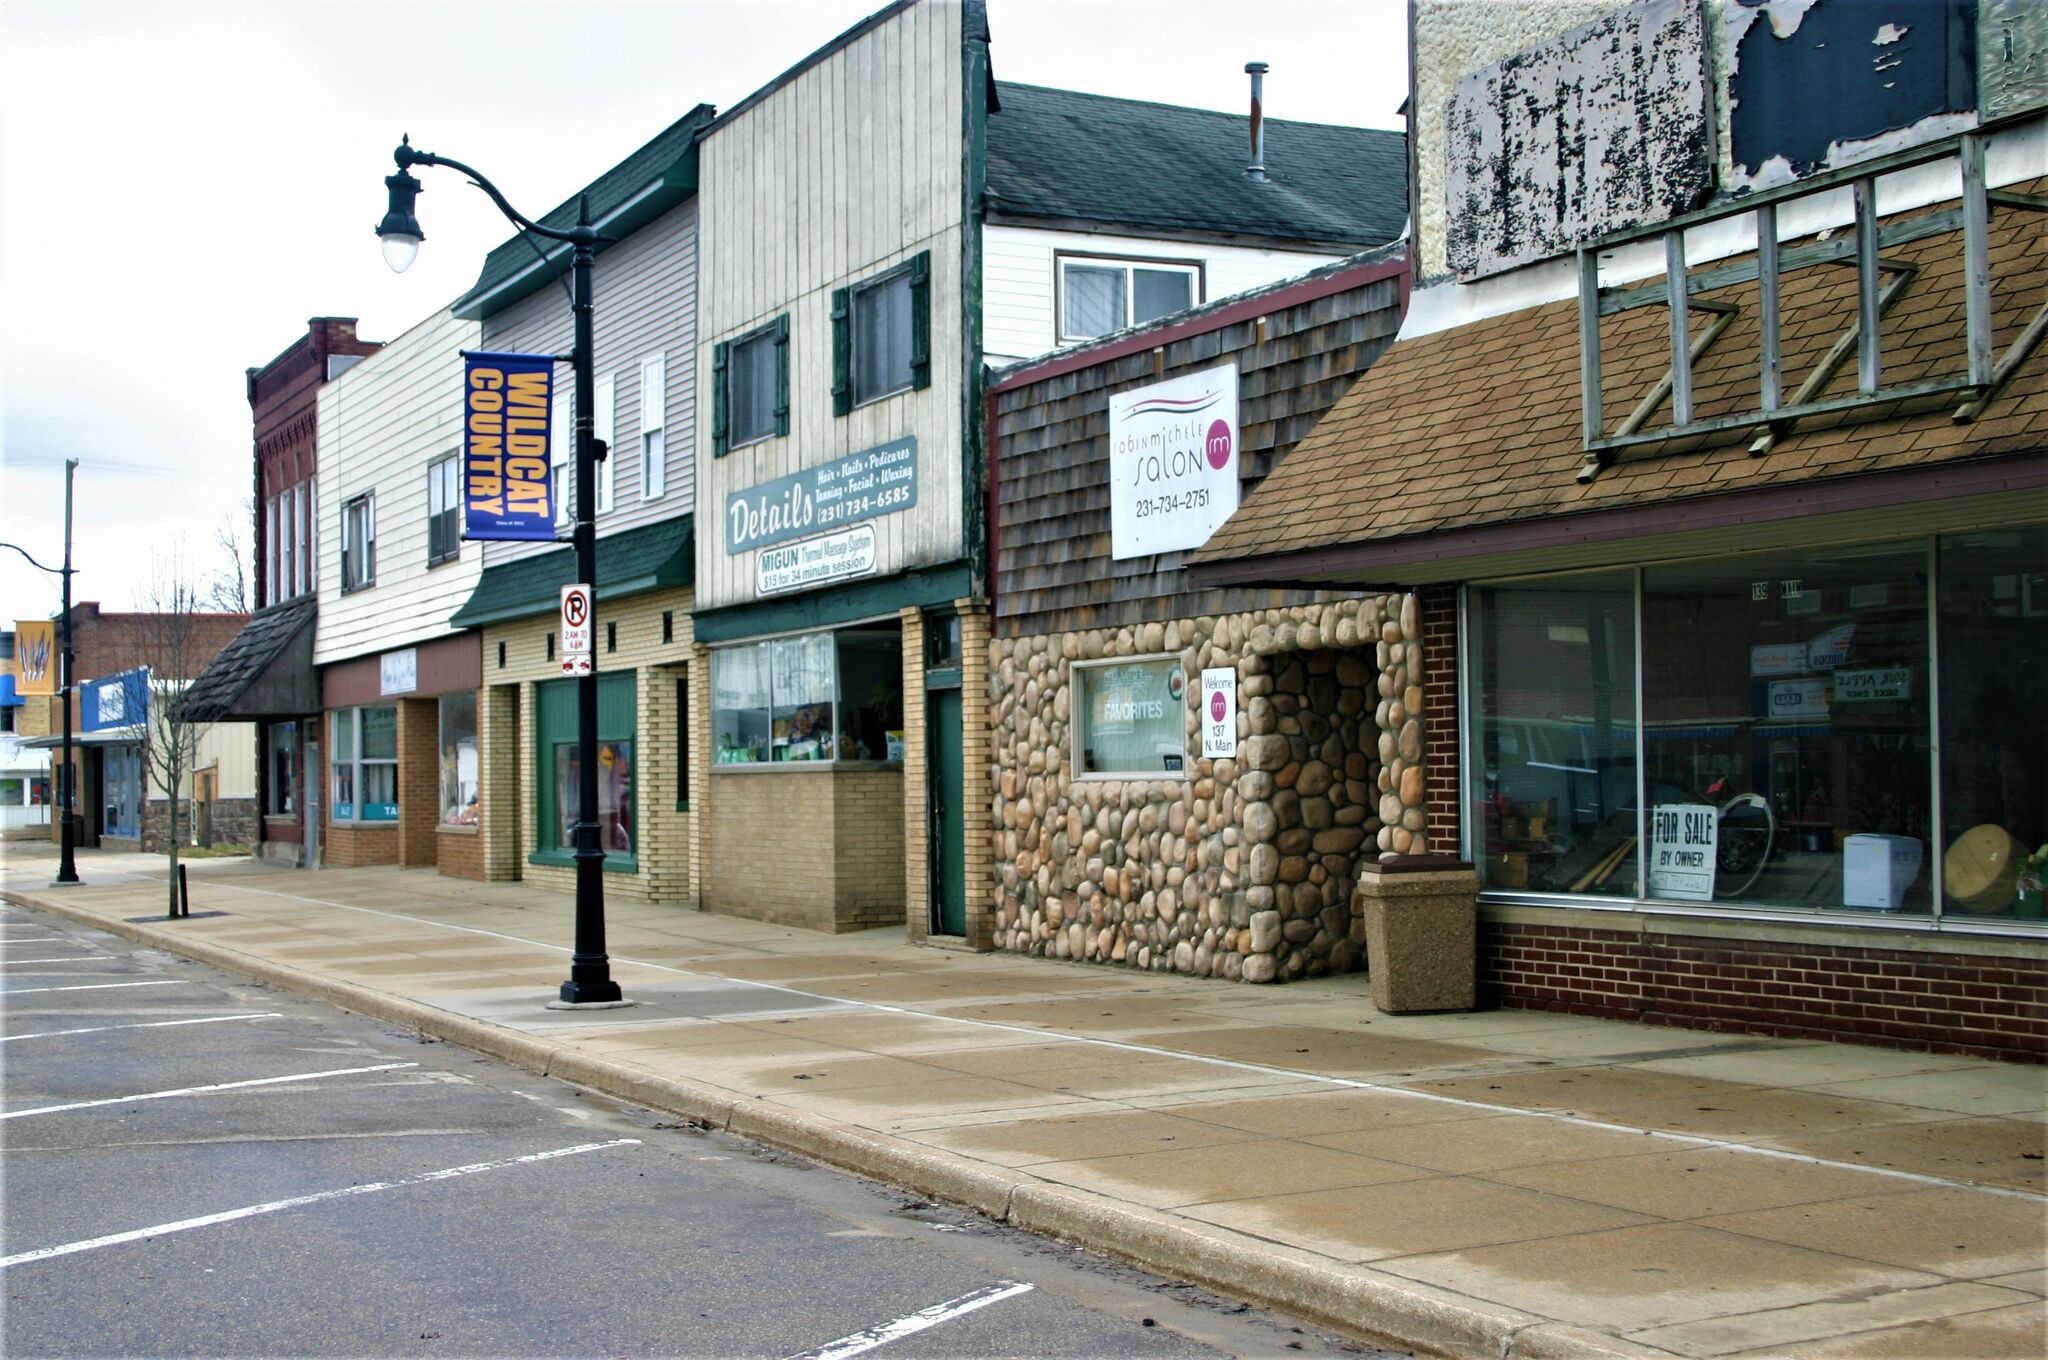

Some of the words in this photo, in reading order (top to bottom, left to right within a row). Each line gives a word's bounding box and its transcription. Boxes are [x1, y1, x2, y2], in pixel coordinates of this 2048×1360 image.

[469, 367, 504, 516] COUNTRY
[506, 372, 549, 518] WILDCAT
[817, 468, 835, 486] Hair
[841, 459, 863, 478] Nails
[869, 447, 910, 469] Pedicures
[815, 486, 843, 503] Tanning
[848, 476, 874, 495] Facial
[881, 466, 913, 485] Waxing
[730, 482, 813, 545] Details
[817, 502, 844, 525] (231)
[847, 485, 909, 517] 734-6585
[1136, 488, 1211, 518] 231-734-2751
[761, 550, 799, 573] MIGUN
[763, 574, 777, 589] $15
[778, 572, 789, 585] for
[791, 568, 801, 582] 34
[802, 563, 830, 580] minute
[832, 555, 866, 574] session
[1752, 583, 1768, 600] 139
[564, 631, 570, 641] 2
[569, 630, 579, 640] AM
[580, 629, 588, 639] TO
[1204, 676, 1233, 690] Welcome
[1104, 701, 1163, 721] FAVORITES
[1212, 725, 1225, 737] 137
[1205, 740, 1213, 751] N.
[1215, 738, 1232, 751] Main
[384, 806, 399, 816] TA
[1656, 812, 1678, 844] FOR
[1684, 812, 1712, 845] SALE
[1660, 851, 1672, 865] BY
[1675, 851, 1704, 867] OWNER
